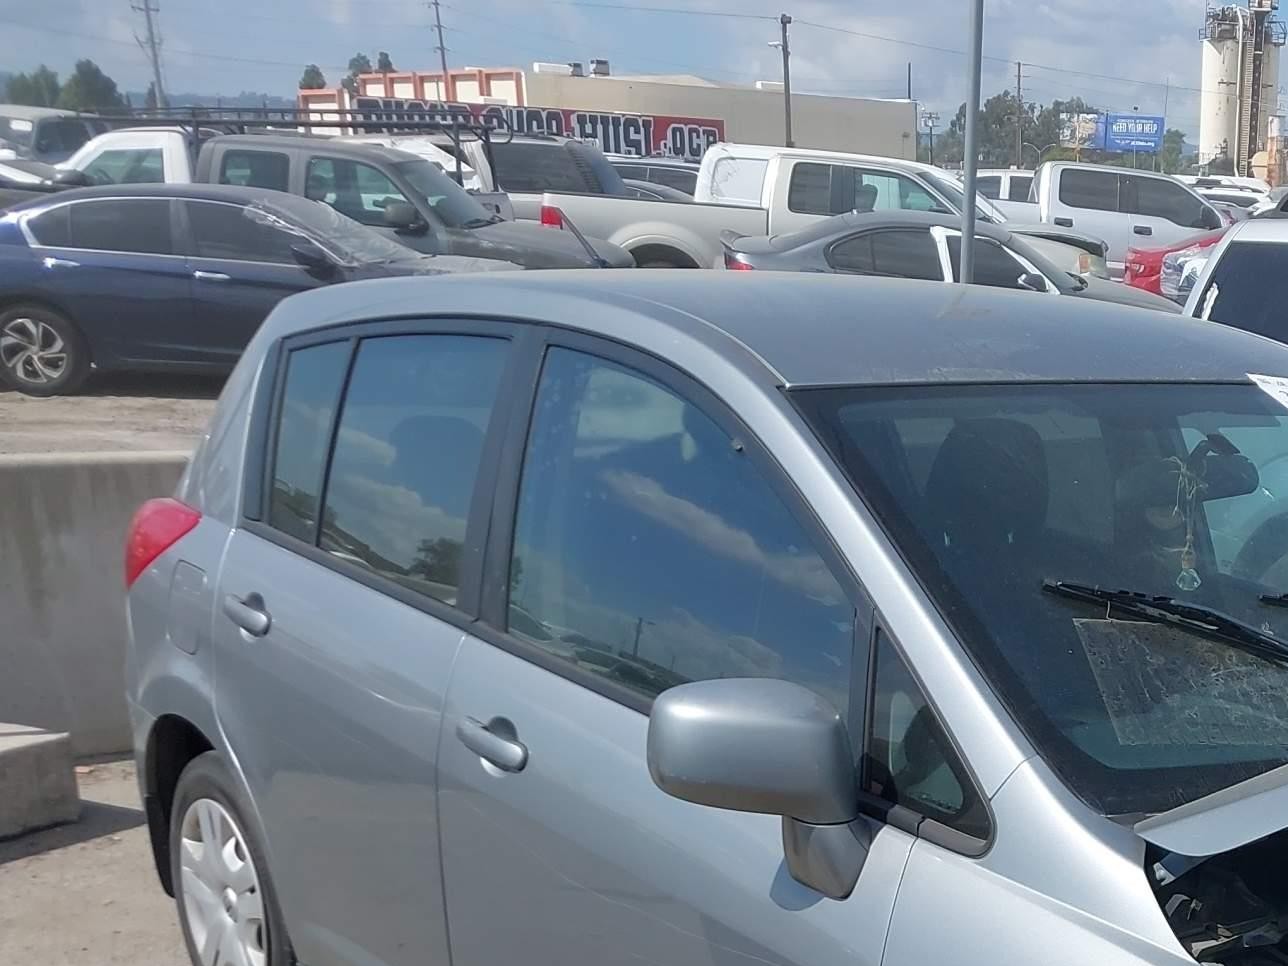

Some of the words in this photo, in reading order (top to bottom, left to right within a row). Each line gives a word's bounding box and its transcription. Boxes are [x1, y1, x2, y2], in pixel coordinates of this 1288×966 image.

[1112, 122, 1127, 132] NEED
[1128, 122, 1143, 133] YOUR
[1143, 123, 1158, 134] HELP
